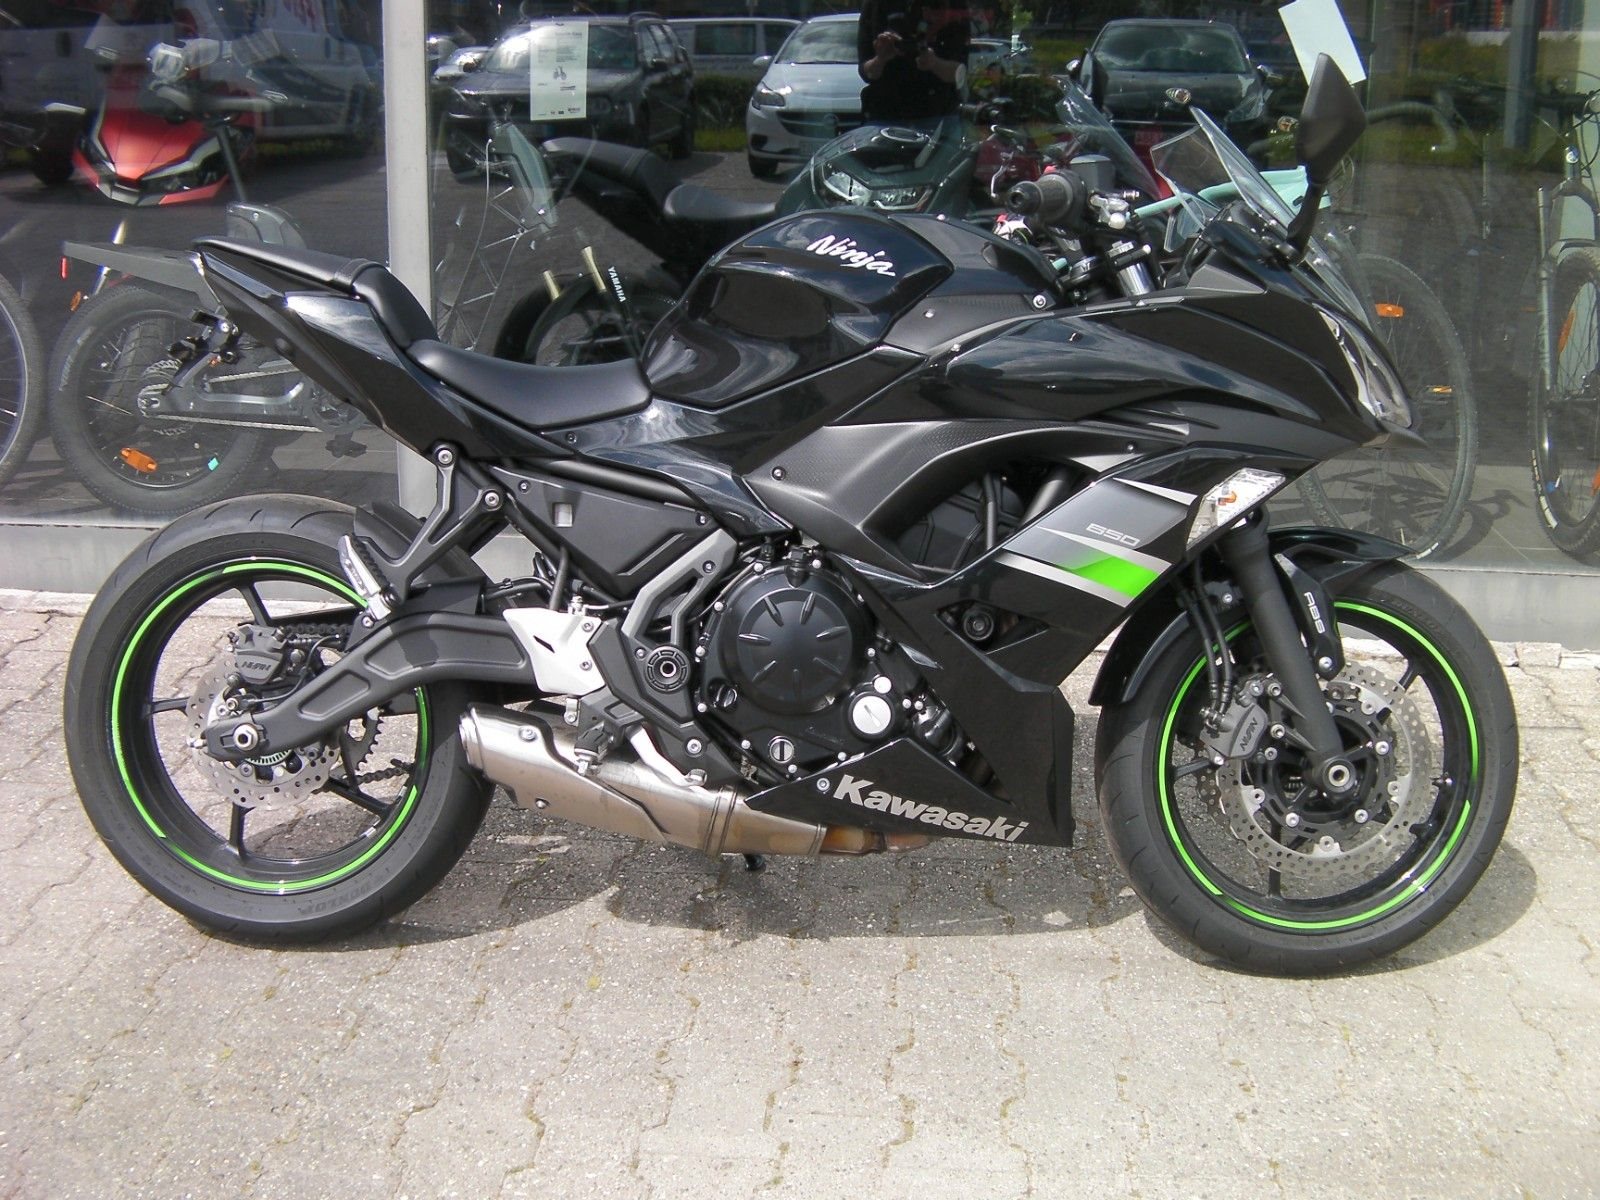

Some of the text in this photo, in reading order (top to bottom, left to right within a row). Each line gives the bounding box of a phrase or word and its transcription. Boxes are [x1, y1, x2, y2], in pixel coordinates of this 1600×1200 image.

[806, 234, 896, 277] Ninja
[608, 265, 627, 303] YAMAHA
[1086, 522, 1140, 547] 650
[1303, 591, 1326, 634] ABS
[833, 774, 1030, 842] Kawasaki
